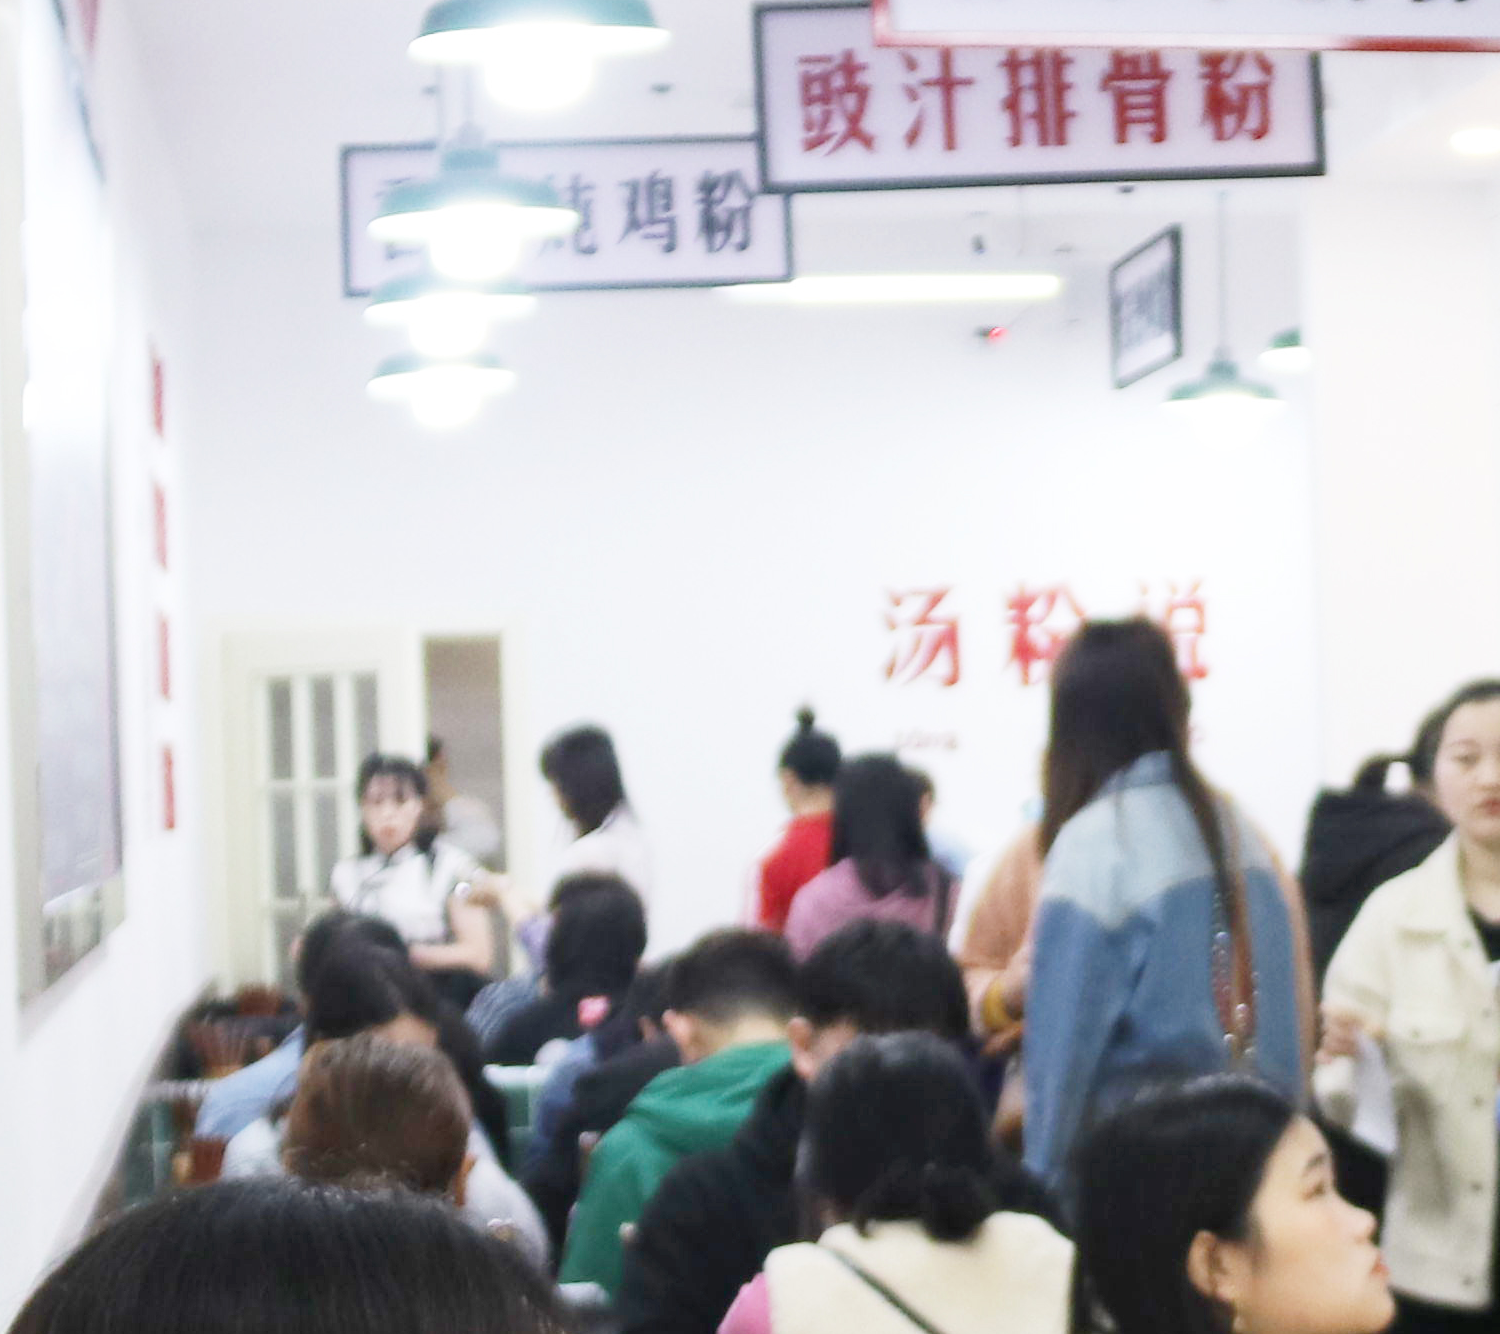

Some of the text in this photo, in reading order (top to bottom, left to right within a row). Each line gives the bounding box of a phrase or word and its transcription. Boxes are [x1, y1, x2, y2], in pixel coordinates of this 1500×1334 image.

[796, 49, 1276, 157] 豉汁排骨粉
